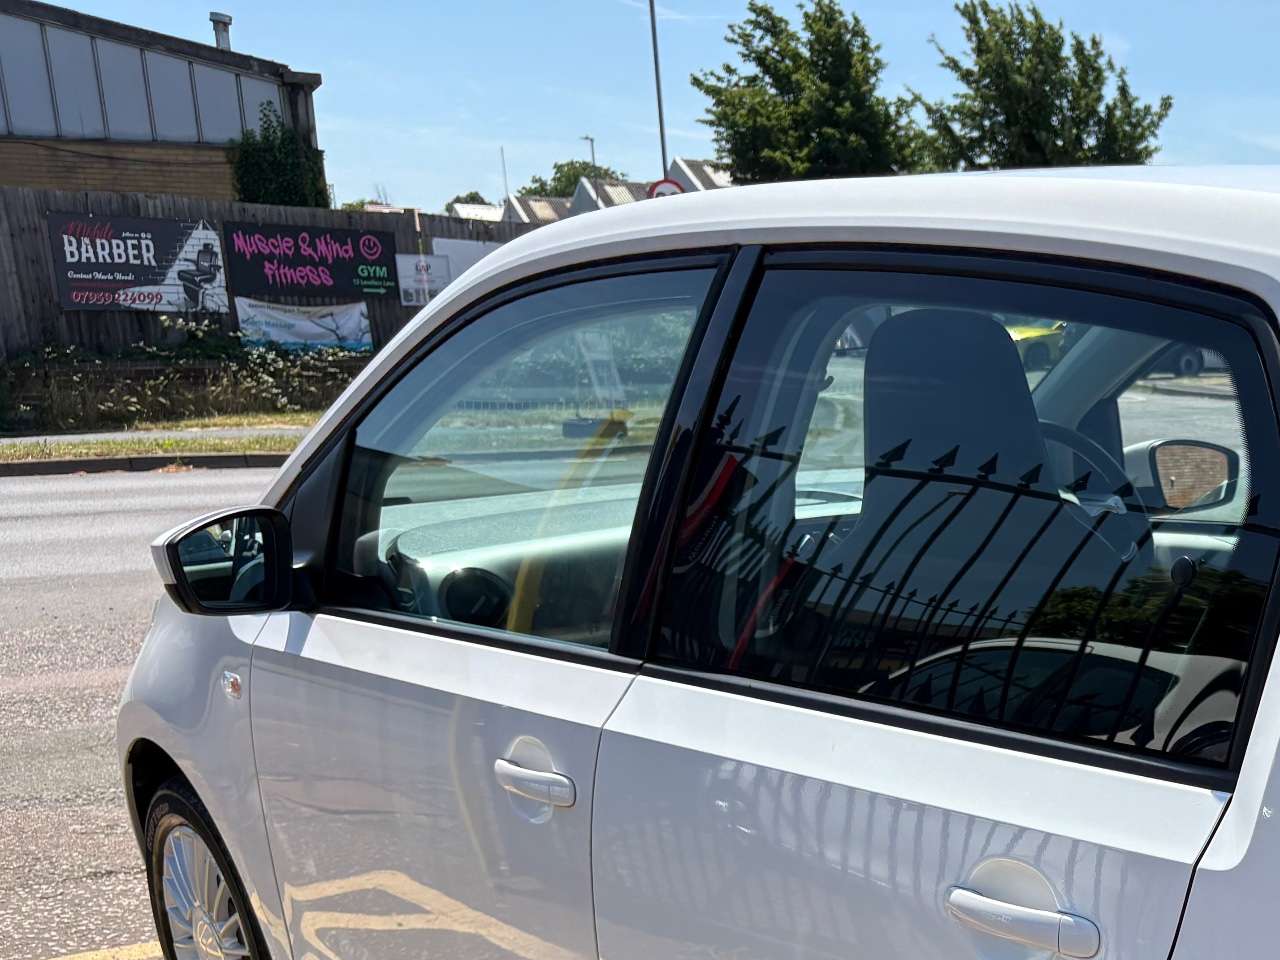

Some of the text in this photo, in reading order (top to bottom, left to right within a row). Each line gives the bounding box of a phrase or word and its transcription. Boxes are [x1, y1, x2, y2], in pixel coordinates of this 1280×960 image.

[63, 234, 158, 266] BARBER
[232, 230, 354, 264] Muscle & Mind
[264, 260, 334, 287] Fitness
[357, 265, 388, 277] GYM
